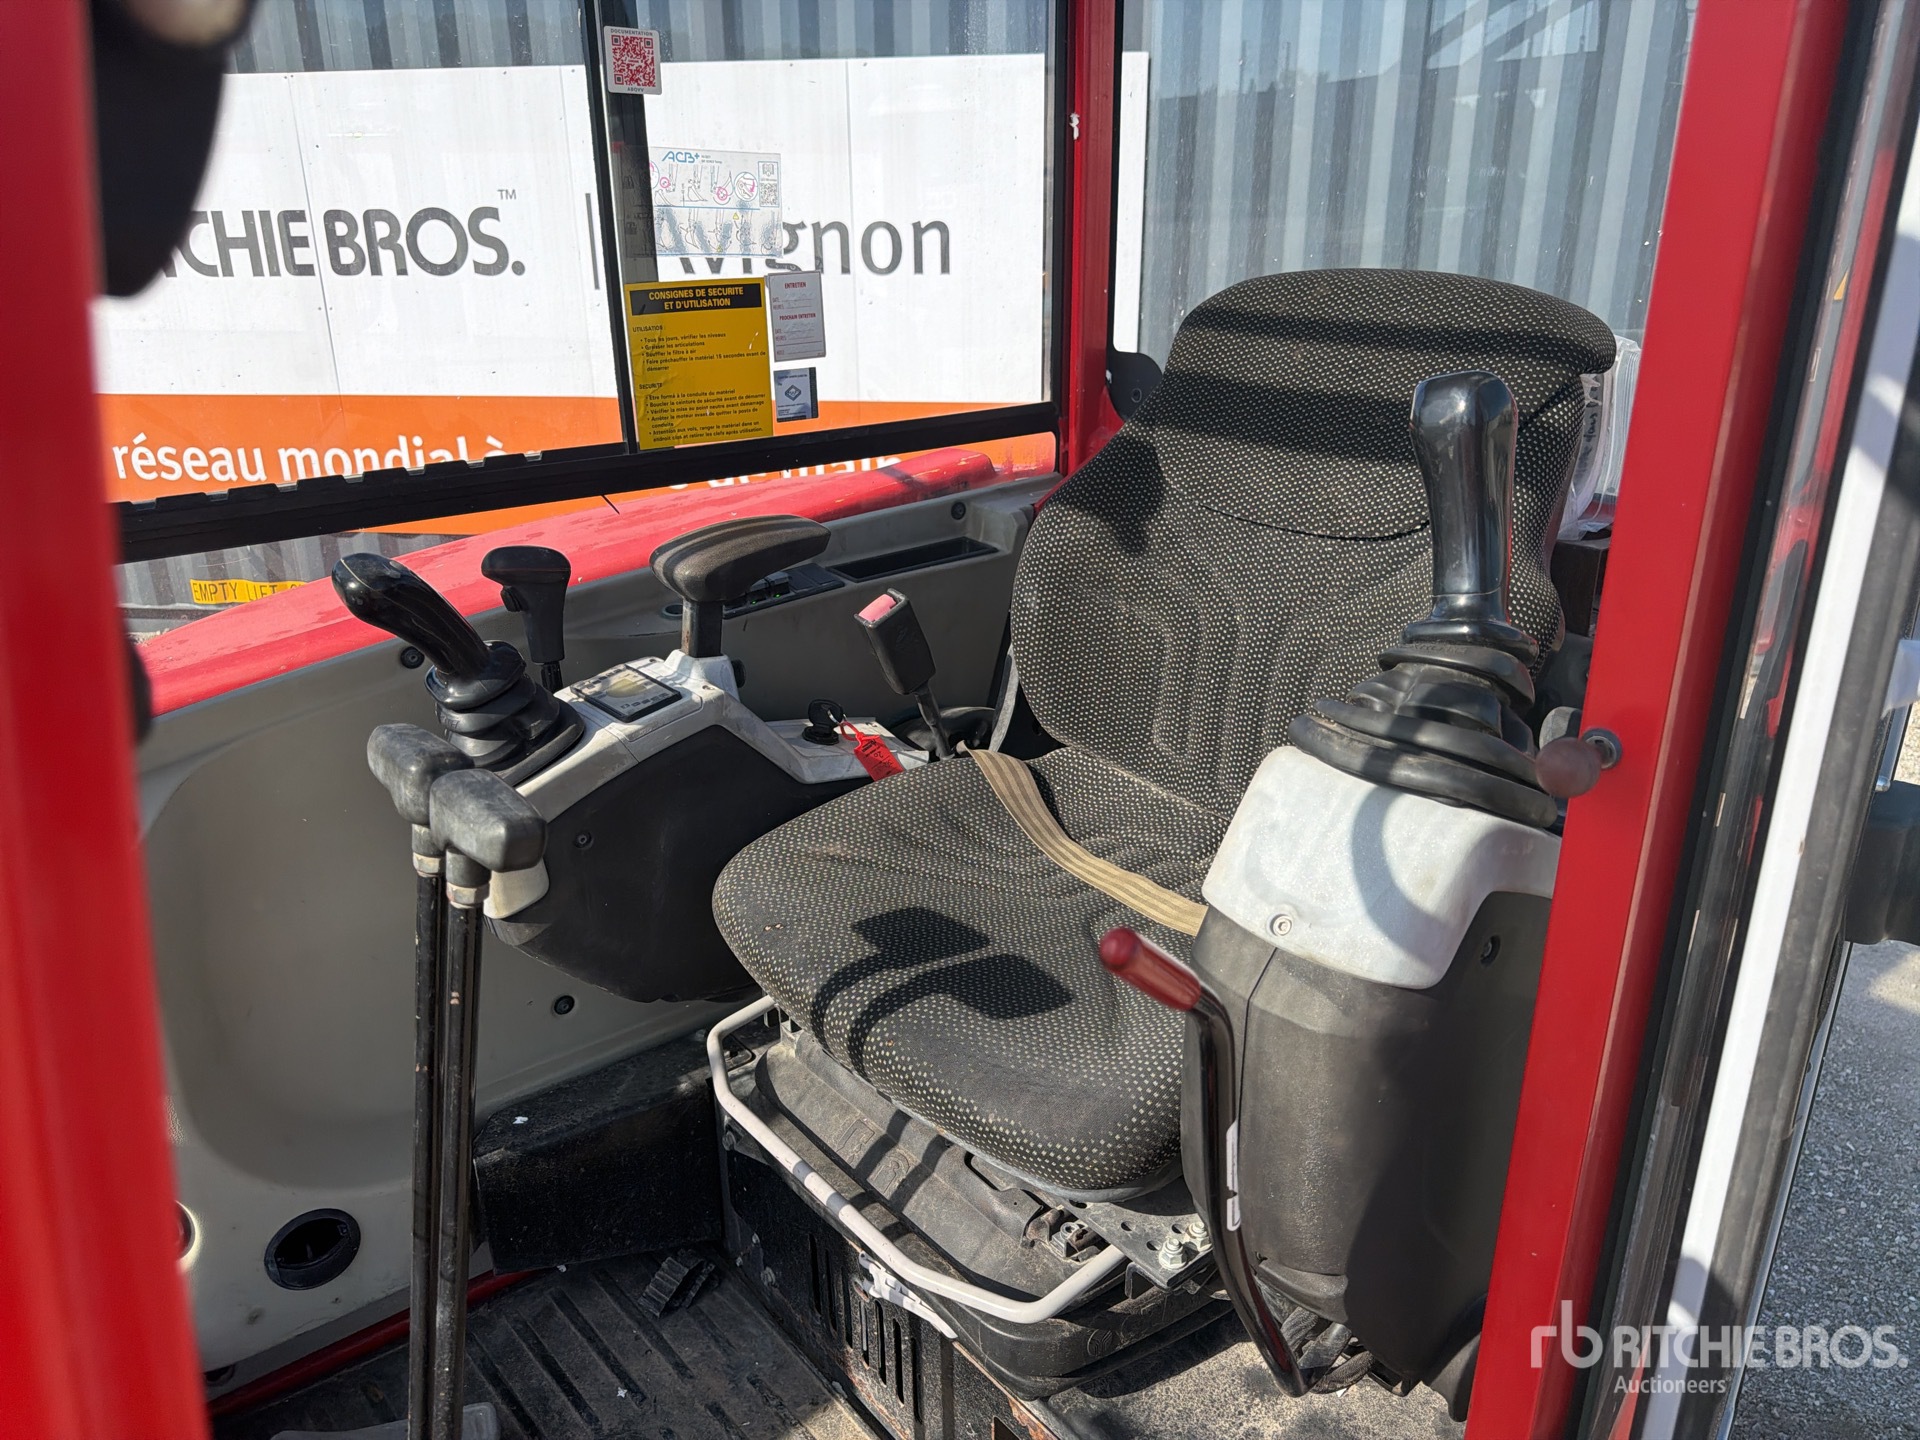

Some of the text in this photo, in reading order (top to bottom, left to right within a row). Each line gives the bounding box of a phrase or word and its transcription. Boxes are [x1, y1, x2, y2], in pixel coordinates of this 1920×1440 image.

[164, 210, 315, 277] CHIE
[324, 206, 526, 276] BROS.
[679, 220, 950, 275] gnon
[649, 286, 744, 300] CONSIGNES DE SECURITE
[664, 298, 731, 310] ET D'UTILISATION
[112, 432, 267, 482] réseau
[193, 582, 238, 601] EMPTY
